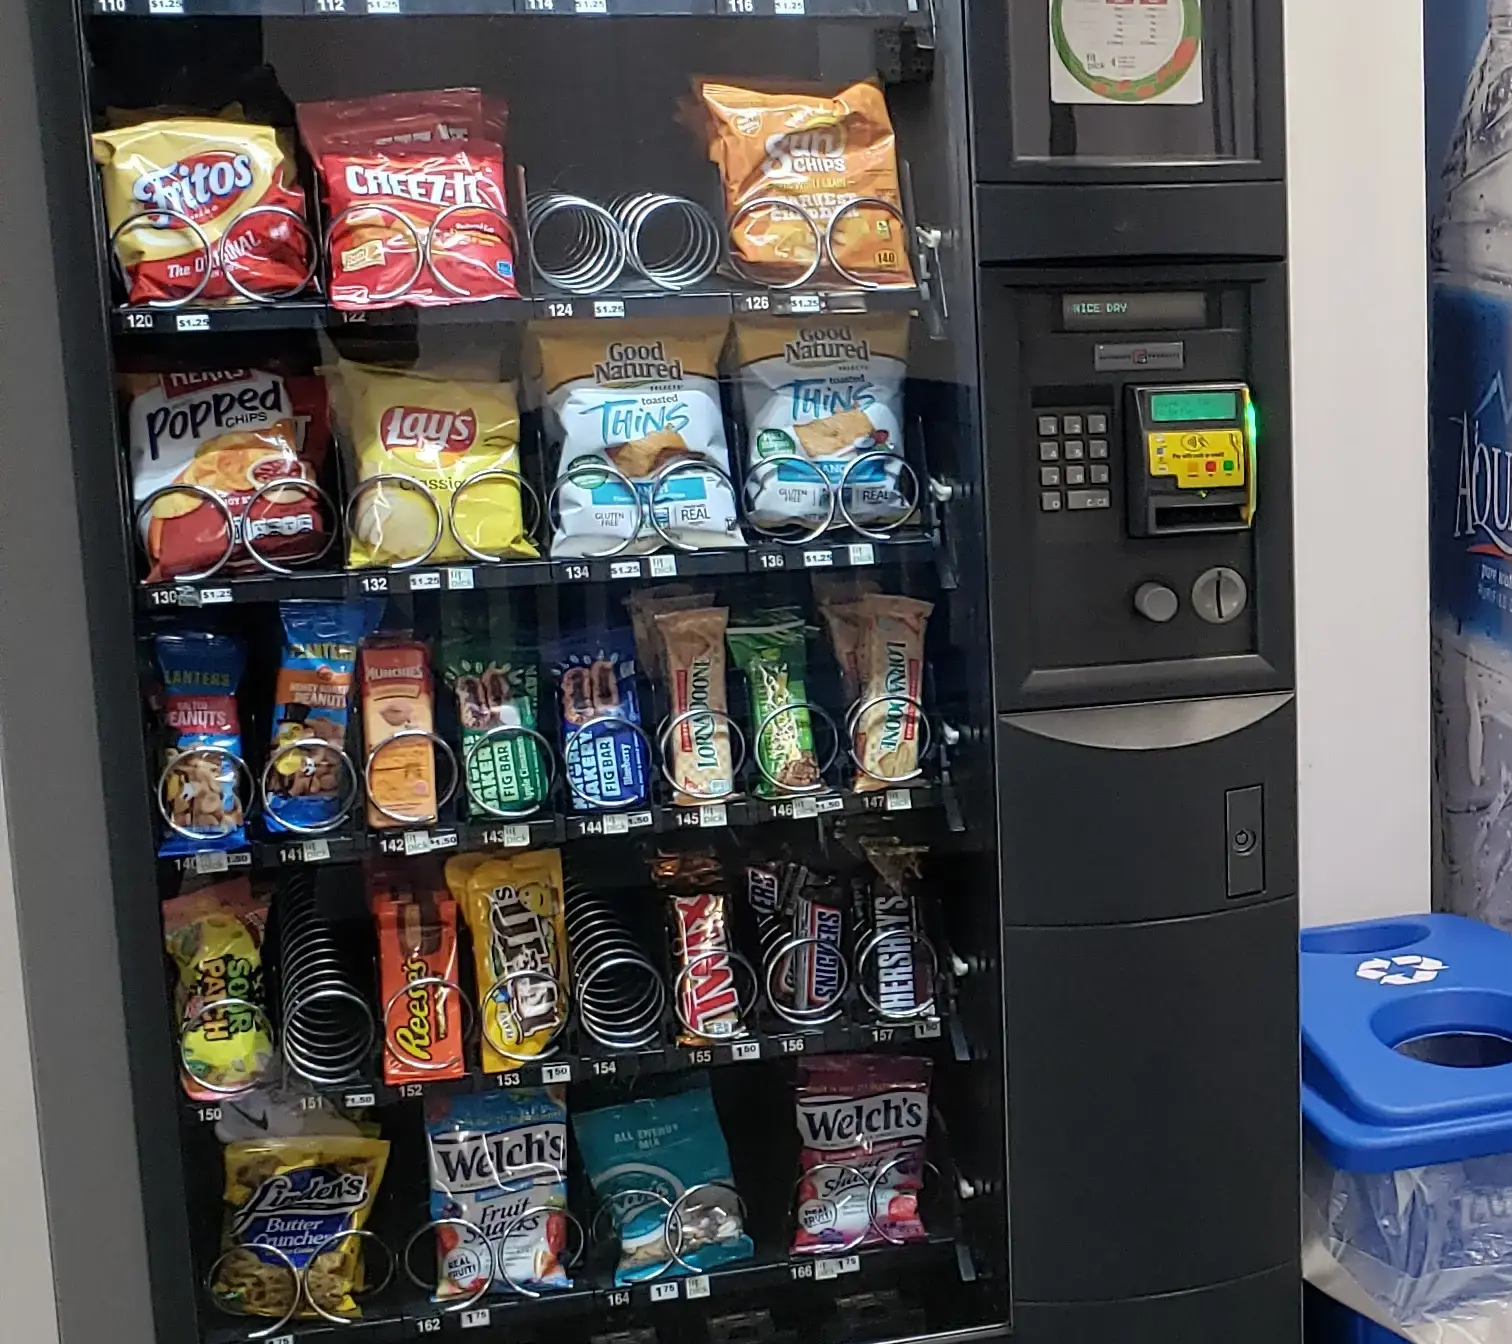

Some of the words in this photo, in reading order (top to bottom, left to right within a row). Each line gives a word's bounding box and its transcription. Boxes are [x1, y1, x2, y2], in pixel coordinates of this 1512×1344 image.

[793, 157, 847, 173] CHIPS
[132, 153, 253, 227] Fritos
[345, 164, 483, 206] CHEEZ-IT
[167, 262, 191, 280] The
[548, 303, 574, 317] 124
[745, 296, 770, 310] 126
[1072, 302, 1100, 314] NICE
[1106, 302, 1128, 314] DAY
[126, 314, 153, 328] 120
[342, 311, 367, 323] 122
[801, 325, 852, 343] Good
[608, 341, 665, 363] Good
[784, 341, 870, 362] Natured
[595, 360, 684, 384] Natured
[828, 373, 866, 385] toasted
[640, 394, 679, 406] toasted
[225, 411, 268, 429] CHIPS
[385, 407, 473, 447] Lay's
[399, 476, 463, 492] Classic
[778, 487, 808, 497] GLUTEN
[862, 488, 891, 502] REAL
[594, 511, 626, 521] GLUTEN
[680, 506, 712, 522] REAL
[600, 519, 620, 528] FREE
[760, 554, 784, 568] 136
[565, 566, 590, 580] 134
[610, 565, 641, 576] $1.25
[363, 577, 388, 592] 132
[365, 665, 423, 681] MUNCHIES
[502, 744, 514, 772] BAR
[603, 738, 615, 767] BAR
[621, 743, 632, 786] Blueberry
[505, 775, 516, 799] FIG
[606, 769, 619, 794] FIG
[863, 795, 885, 808] 147
[770, 804, 792, 816] 146
[676, 813, 699, 825] 145
[579, 821, 602, 834] 144
[380, 839, 404, 852] 142
[280, 849, 302, 862] 141
[677, 894, 738, 1025] TWIX
[813, 908, 841, 1001] SNICKERS
[874, 895, 915, 1012] HERSHEY'S
[201, 957, 230, 1042] PATCH
[227, 957, 253, 1033] SOUR
[871, 1028, 894, 1041] 157
[781, 1039, 804, 1052] 156
[688, 1050, 712, 1063] 155
[592, 1061, 617, 1075] 154
[496, 1073, 520, 1086] 153
[399, 1084, 423, 1097] 152
[301, 1097, 323, 1110] 151
[198, 1108, 222, 1121] 150
[802, 1098, 923, 1141] Welch's
[437, 1130, 567, 1183] Welch's
[231, 1173, 370, 1236] Linden's
[480, 1198, 530, 1226] Fruit
[264, 1217, 323, 1233] Butter
[790, 1266, 813, 1279] 166
[607, 1293, 630, 1306] 164
[416, 1319, 441, 1332] 162
